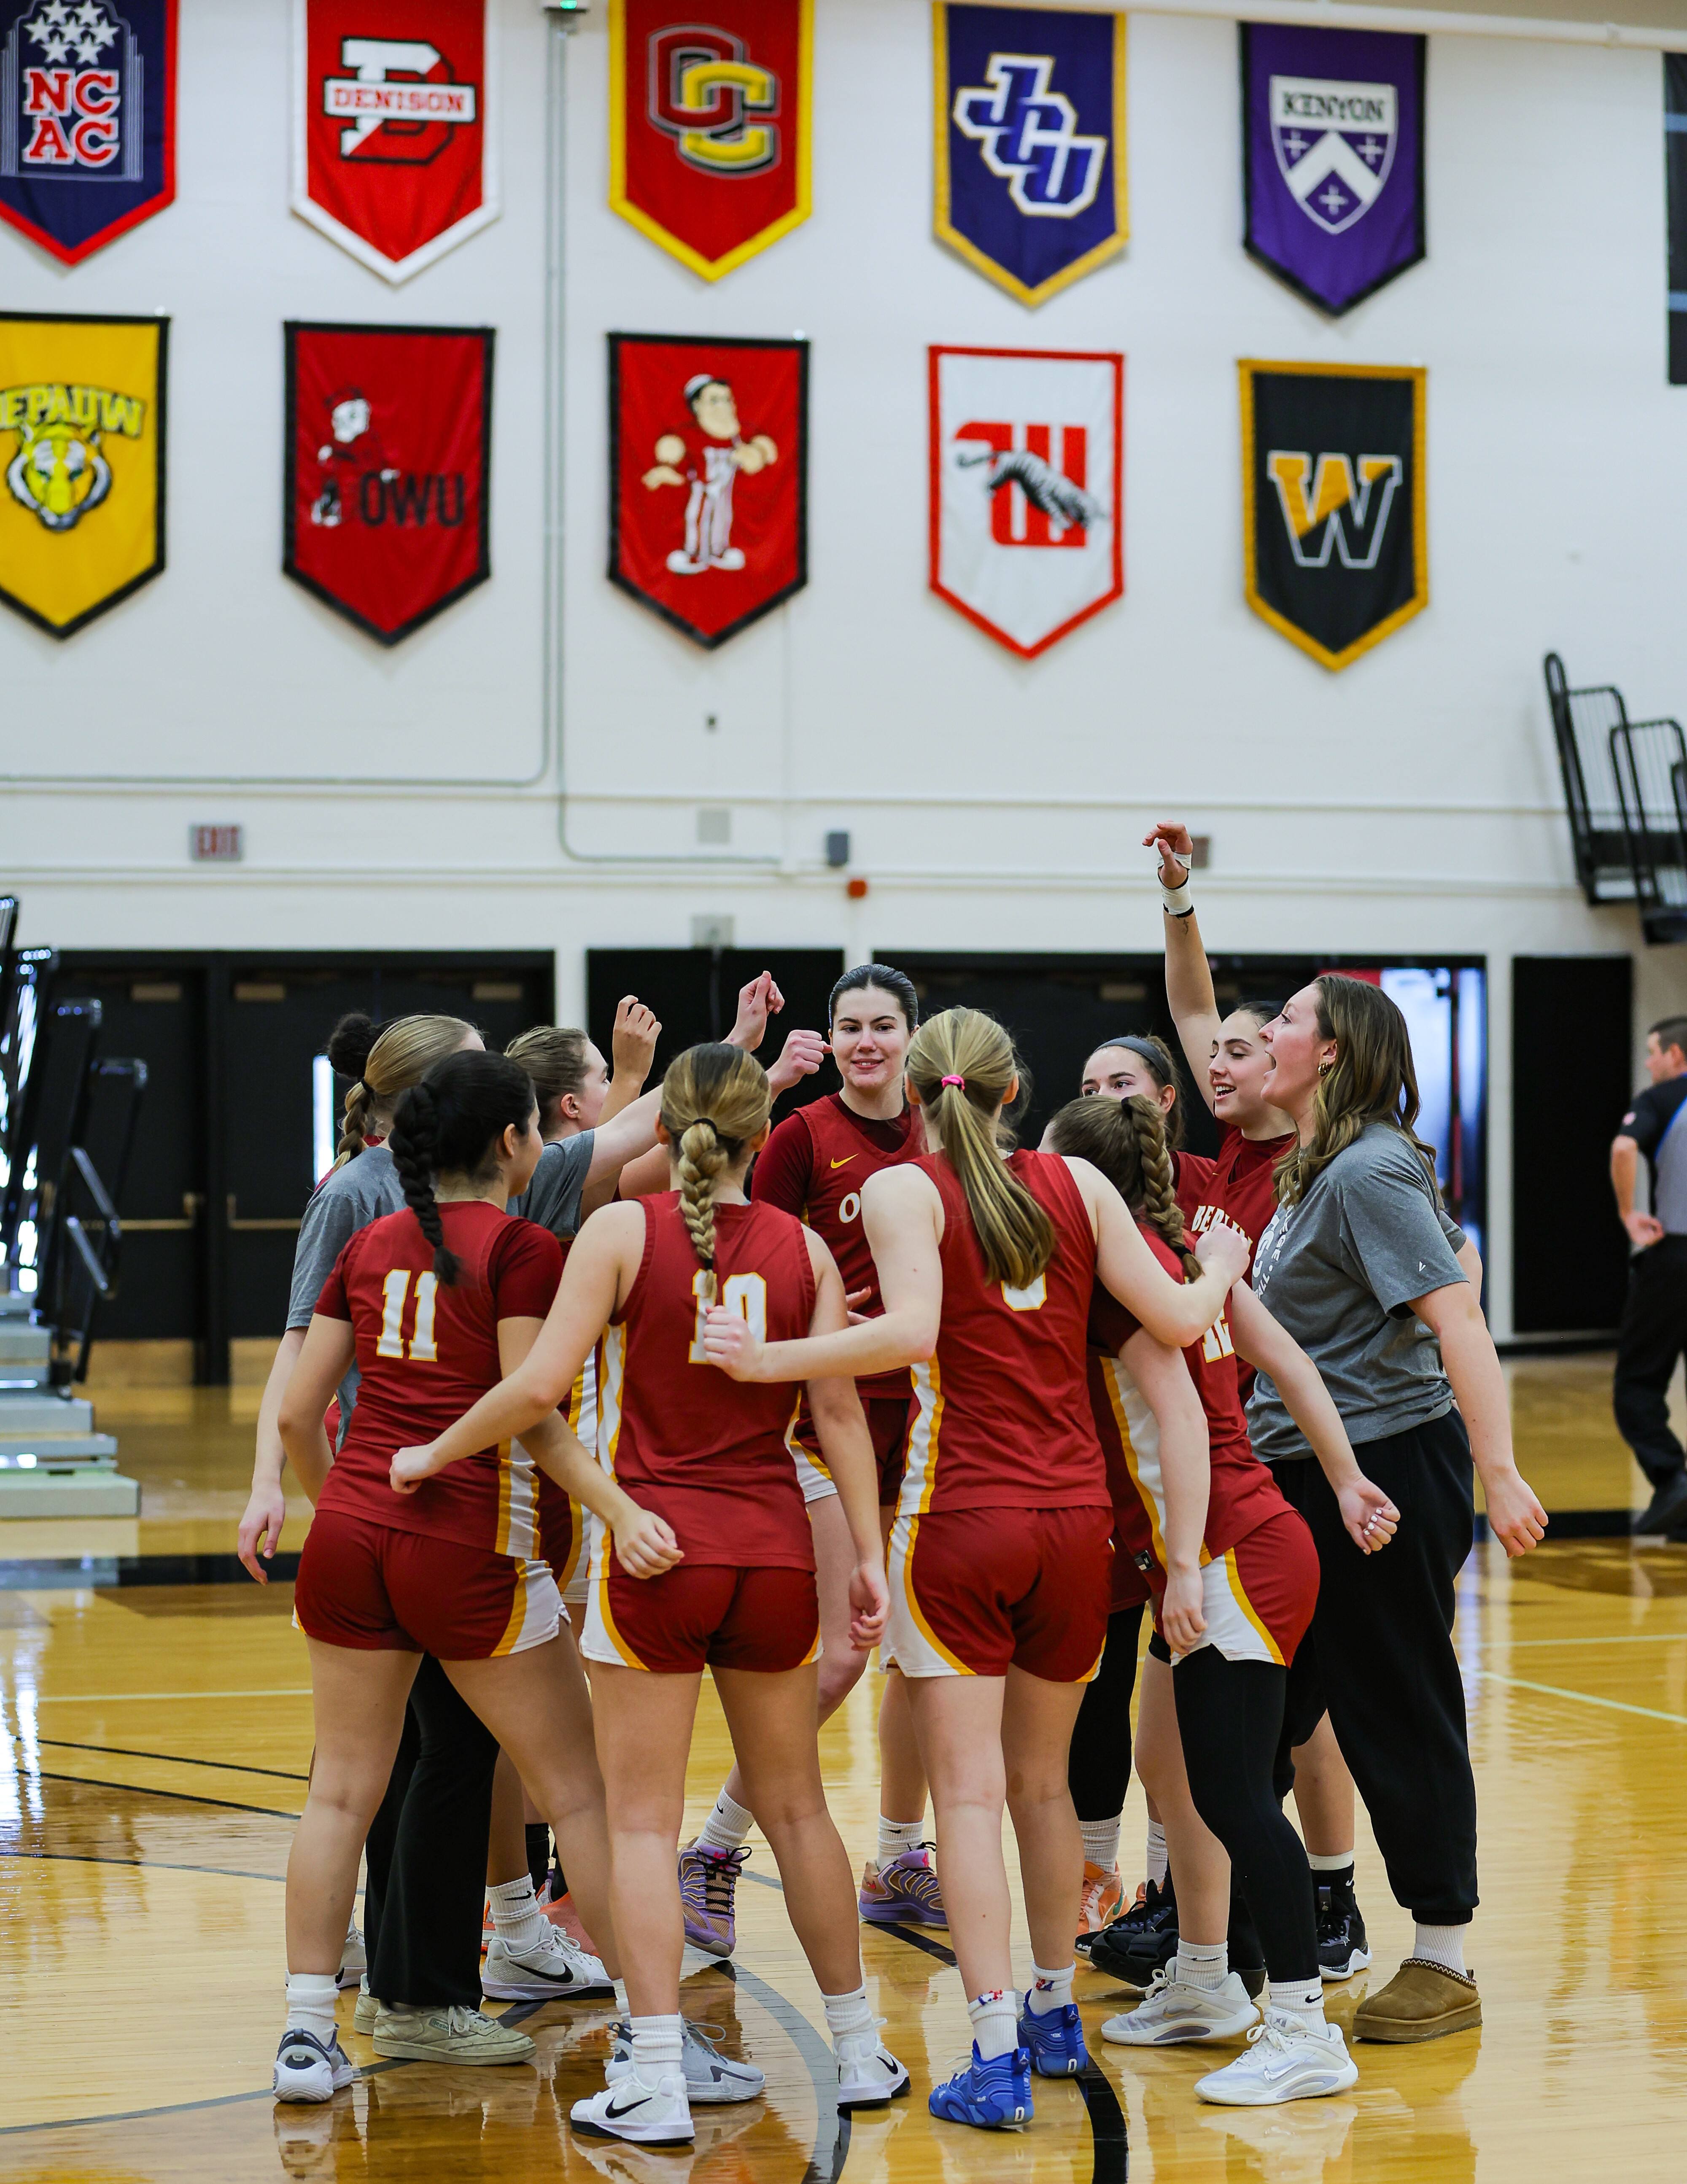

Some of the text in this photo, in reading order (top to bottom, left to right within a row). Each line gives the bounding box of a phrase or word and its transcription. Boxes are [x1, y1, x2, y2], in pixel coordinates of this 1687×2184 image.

[335, 87, 463, 112] DENISON
[954, 53, 1107, 218] JCU
[1283, 91, 1385, 122] KENYON
[0, 384, 146, 439] EPAUW
[359, 469, 465, 528] OWU
[1268, 450, 1401, 569] W
[376, 1269, 439, 1362] 11
[688, 1268, 767, 1365] 10
